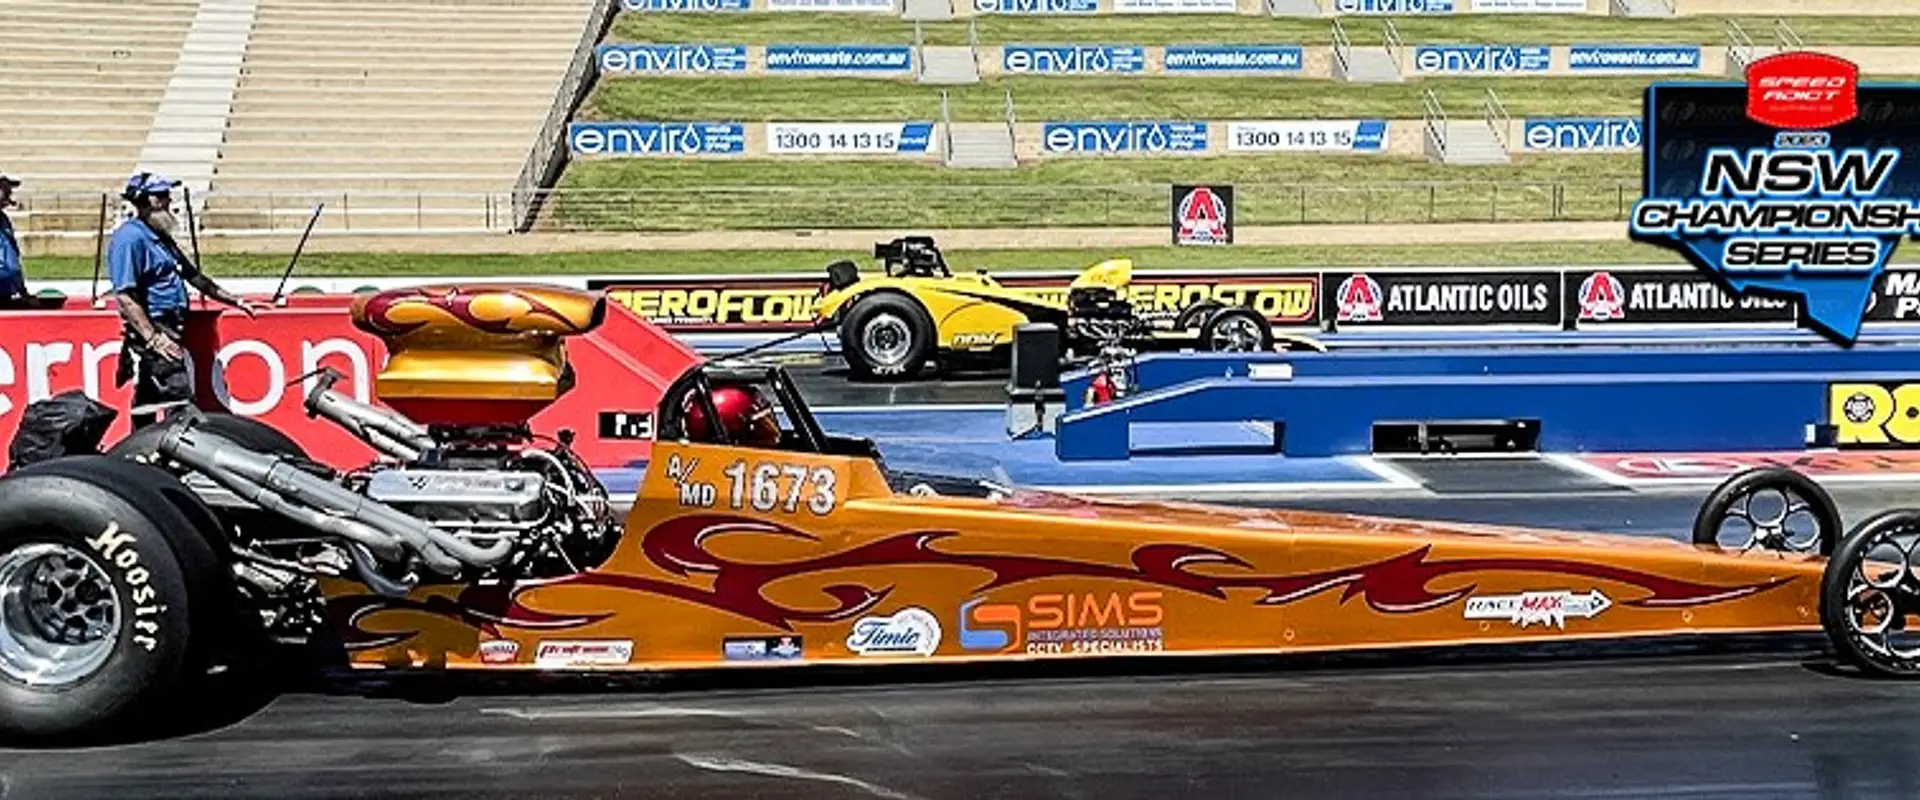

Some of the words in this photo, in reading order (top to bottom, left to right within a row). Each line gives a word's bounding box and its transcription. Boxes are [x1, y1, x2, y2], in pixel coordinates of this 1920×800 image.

[603, 46, 711, 71] enviro
[1006, 46, 1110, 72] enviro
[1417, 46, 1515, 71] enviro
[575, 122, 700, 153] enviro
[776, 131, 821, 149] 1300
[828, 132, 847, 149] 14
[853, 132, 871, 149] 13
[875, 132, 894, 149] 15
[1047, 122, 1167, 151] enviro
[1236, 131, 1280, 146] 1300
[1286, 131, 1305, 146] 14
[1309, 131, 1327, 146] 13
[1333, 131, 1351, 146] 15
[1527, 119, 1642, 149] enviro
[1884, 272, 1920, 296] MA
[1122, 283, 1311, 317] EROFLOW
[1387, 284, 1494, 312] ATLANTIC
[1498, 283, 1549, 312] OILS
[1895, 297, 1920, 318] P
[680, 481, 717, 507] MD
[724, 457, 837, 517] 1673
[1028, 591, 1164, 629] SIMS
[1026, 641, 1065, 655] CCTV
[1072, 639, 1164, 653] SPECIALISTS
